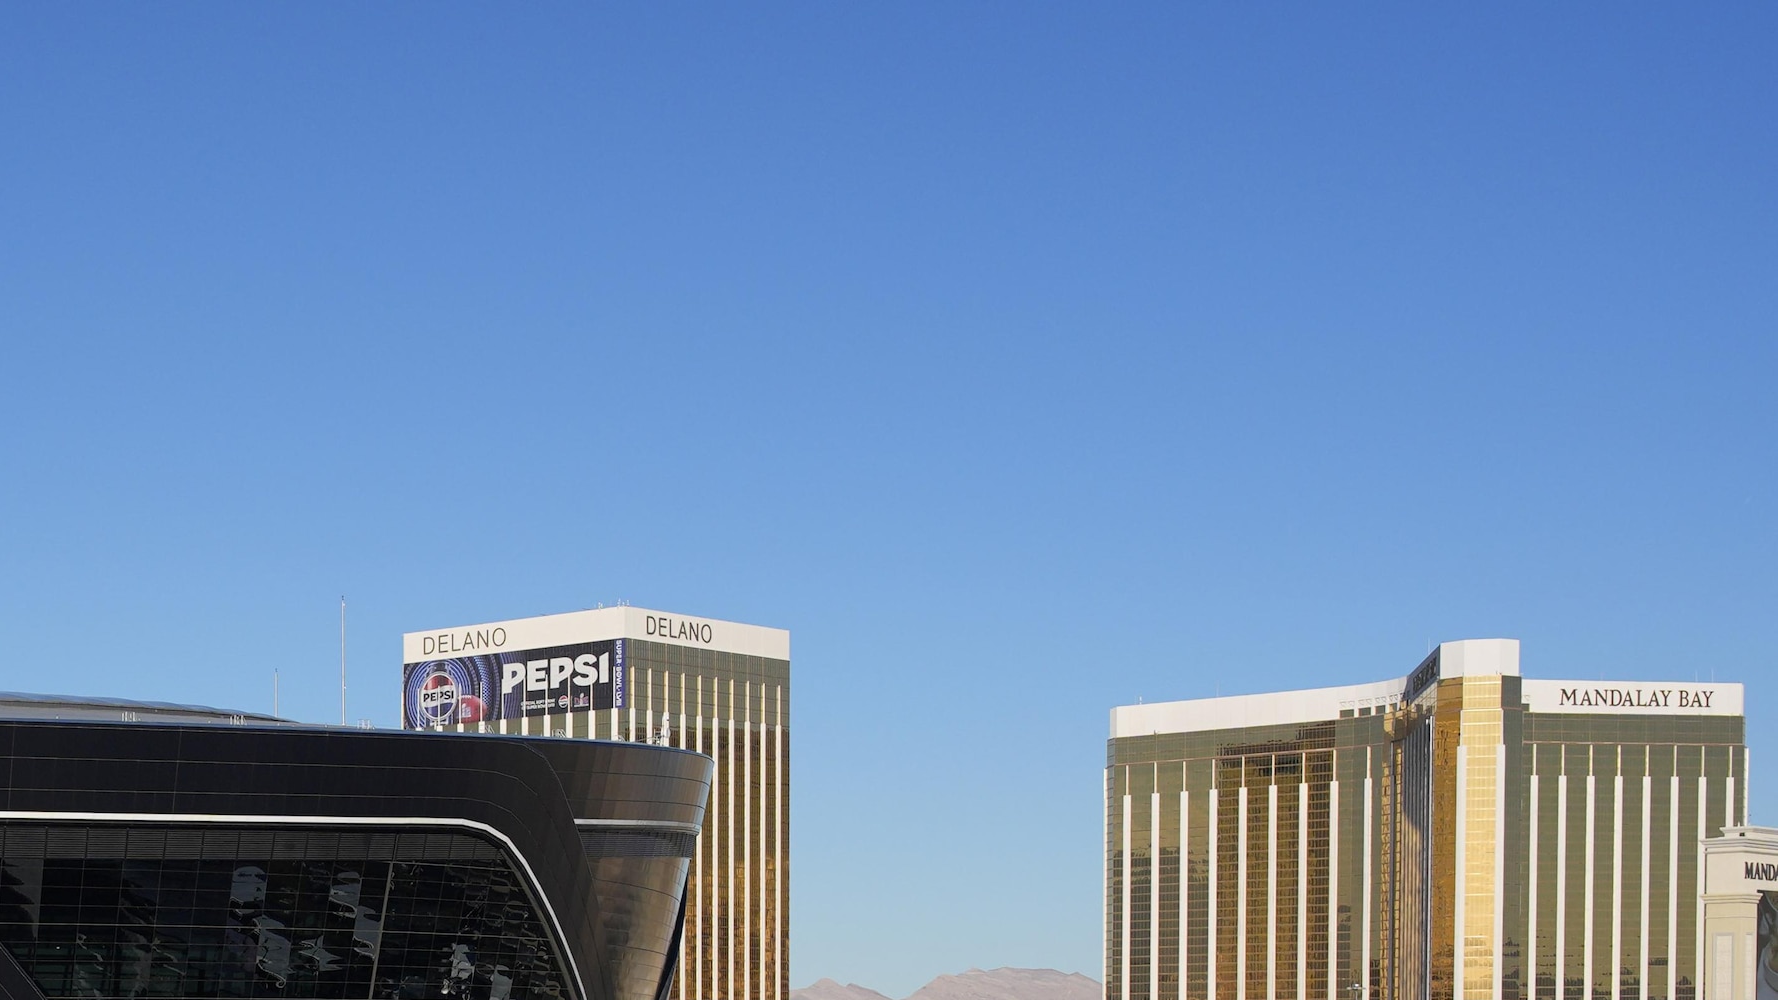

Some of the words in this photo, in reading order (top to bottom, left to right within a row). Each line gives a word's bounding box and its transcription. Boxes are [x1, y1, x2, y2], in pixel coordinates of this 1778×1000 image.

[423, 628, 507, 655] DELANO
[646, 615, 712, 644] DELANO
[502, 652, 610, 694] PEPSI
[423, 690, 454, 702] PEPSI
[1559, 688, 1672, 707] MANDALAY
[1678, 690, 1715, 708] BAY
